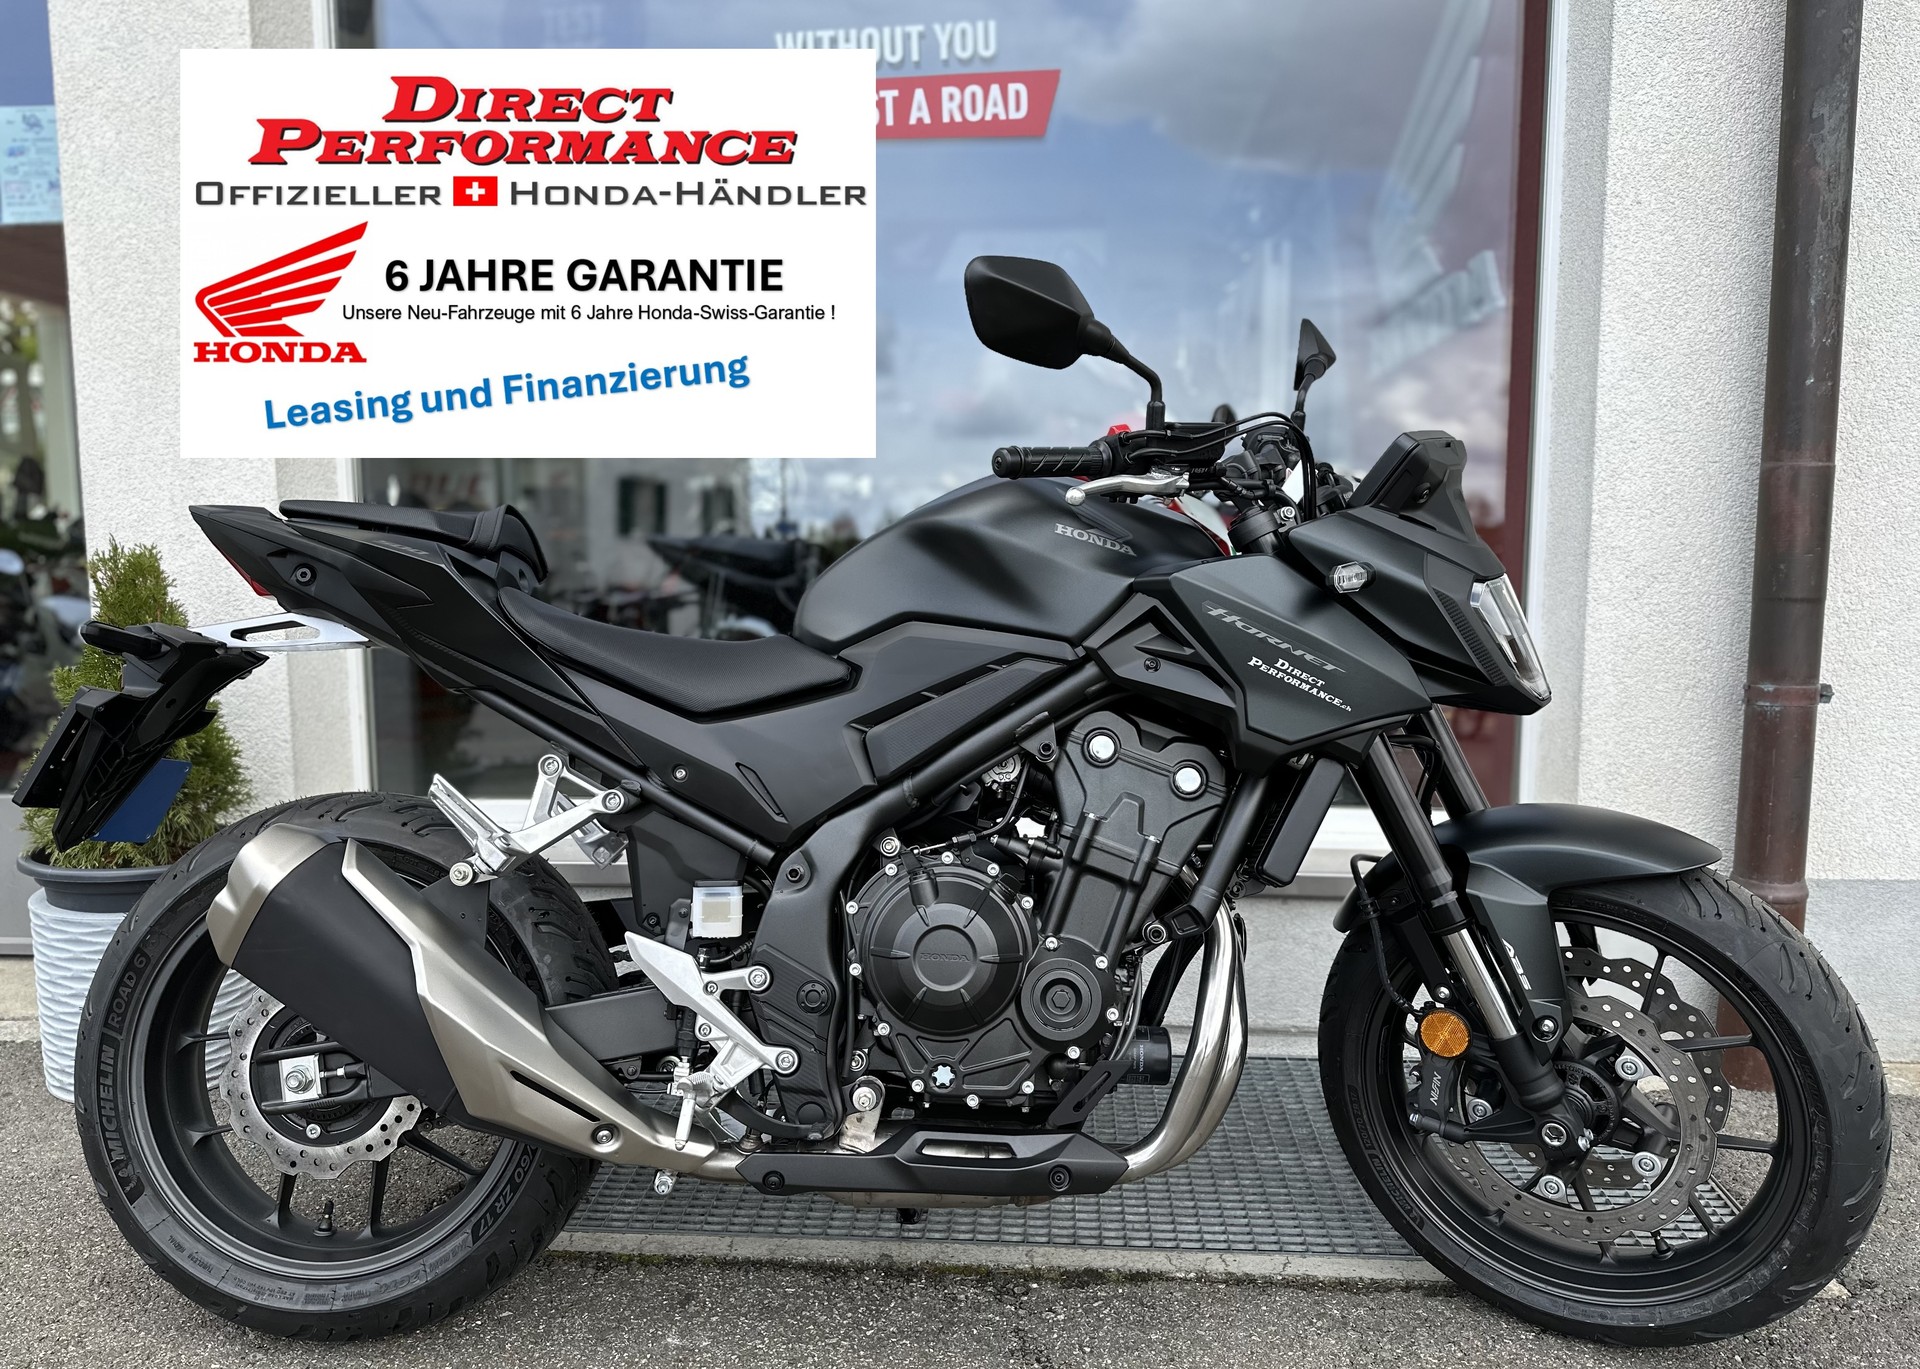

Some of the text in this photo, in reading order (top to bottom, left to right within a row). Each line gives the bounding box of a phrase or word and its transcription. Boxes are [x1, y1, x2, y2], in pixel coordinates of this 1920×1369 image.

[933, 20, 997, 60] YOU
[909, 88, 931, 125] A
[941, 82, 1028, 123] ROAD
[1054, 522, 1138, 557] HONDA
[1201, 602, 1348, 675] HORNET
[1276, 656, 1326, 688] DIRECT
[919, 952, 971, 963] HONDA
[1501, 938, 1533, 991] ABS
[99, 955, 147, 1163] MICHELIN ROAD 6
[495, 1184, 514, 1214] ZR
[1371, 1157, 1412, 1212] MICHELIN
[479, 1212, 494, 1237] 17
